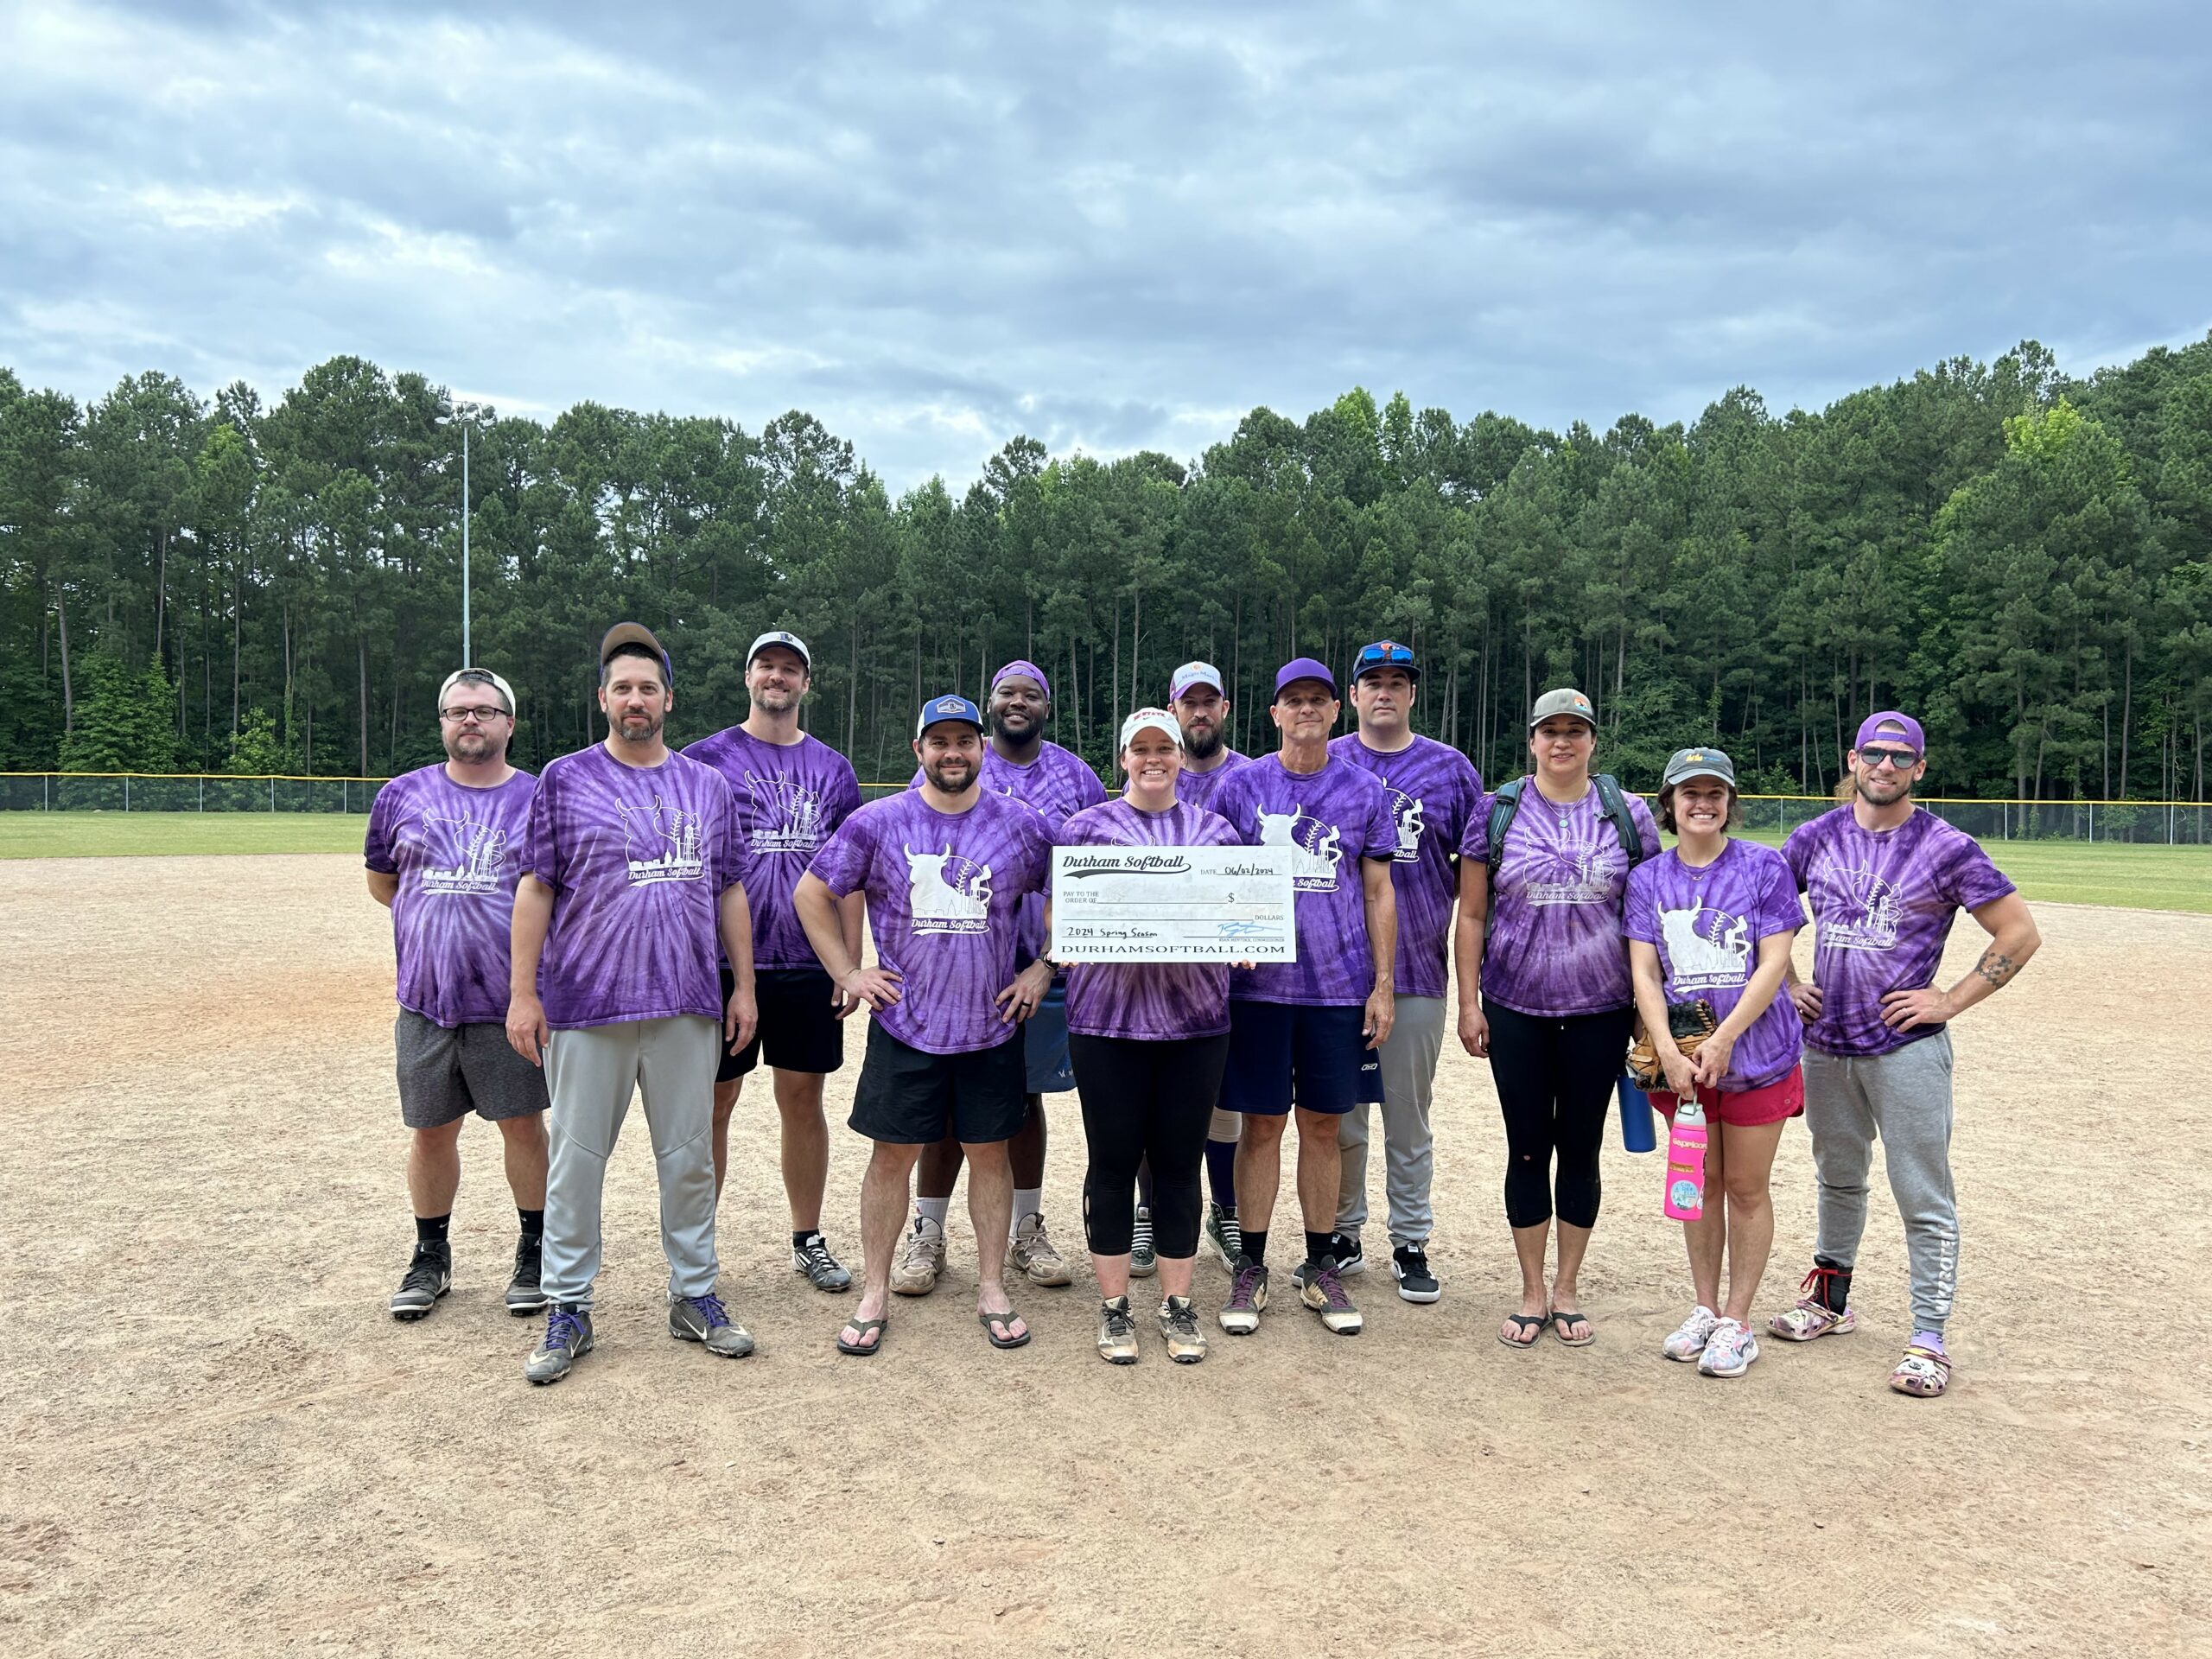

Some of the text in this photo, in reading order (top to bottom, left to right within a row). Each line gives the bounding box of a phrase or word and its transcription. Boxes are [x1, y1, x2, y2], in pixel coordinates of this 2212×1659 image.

[752, 838, 815, 849] Durham Softball
[1062, 855, 1184, 871] Durham Softball
[628, 867, 701, 880] Durham Softball
[1224, 863, 1274, 876] 06/02/2024
[421, 880, 498, 892] Durham Softball
[1297, 878, 1335, 889] Softball
[1228, 892, 1235, 904] $
[1526, 891, 1565, 899] Durham
[912, 918, 987, 931] Durham Softball
[1066, 926, 1158, 940] 2024 Spring Season
[1821, 932, 1895, 947] Dham Softball
[1708, 973, 1745, 985] Softball
